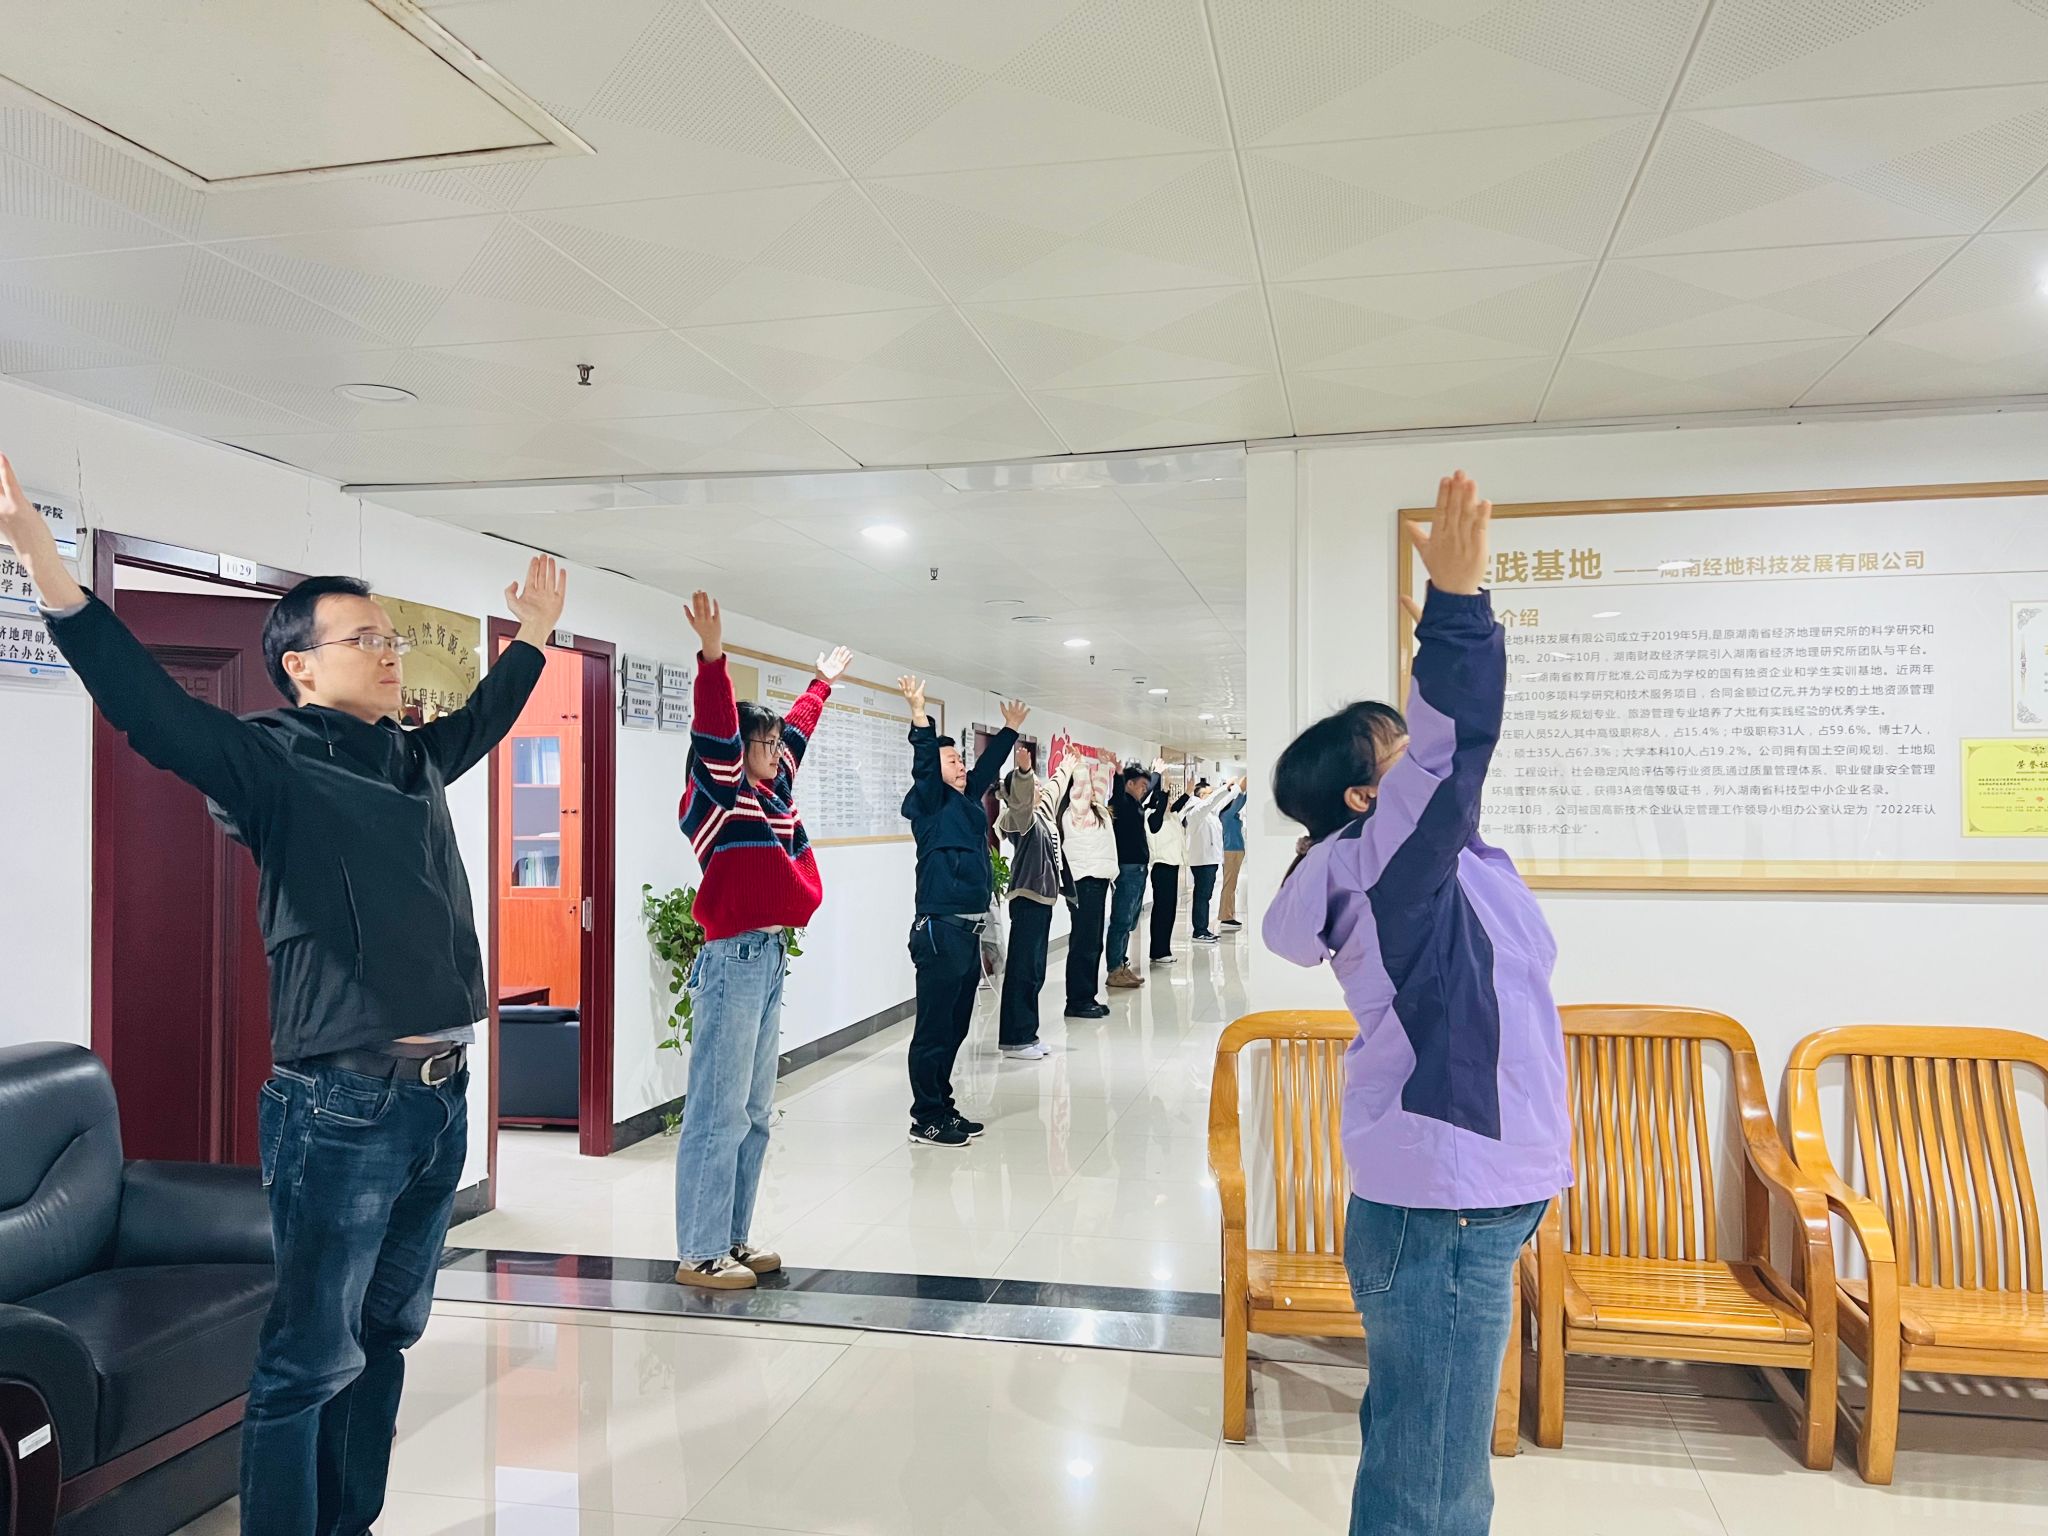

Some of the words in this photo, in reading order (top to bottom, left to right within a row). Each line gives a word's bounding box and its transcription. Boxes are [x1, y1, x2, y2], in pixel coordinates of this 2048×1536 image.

[0, 559, 28, 578] 济地
[226, 562, 252, 577] 1029
[1499, 608, 1540, 628] 介绍
[0, 625, 54, 645] 济地理研
